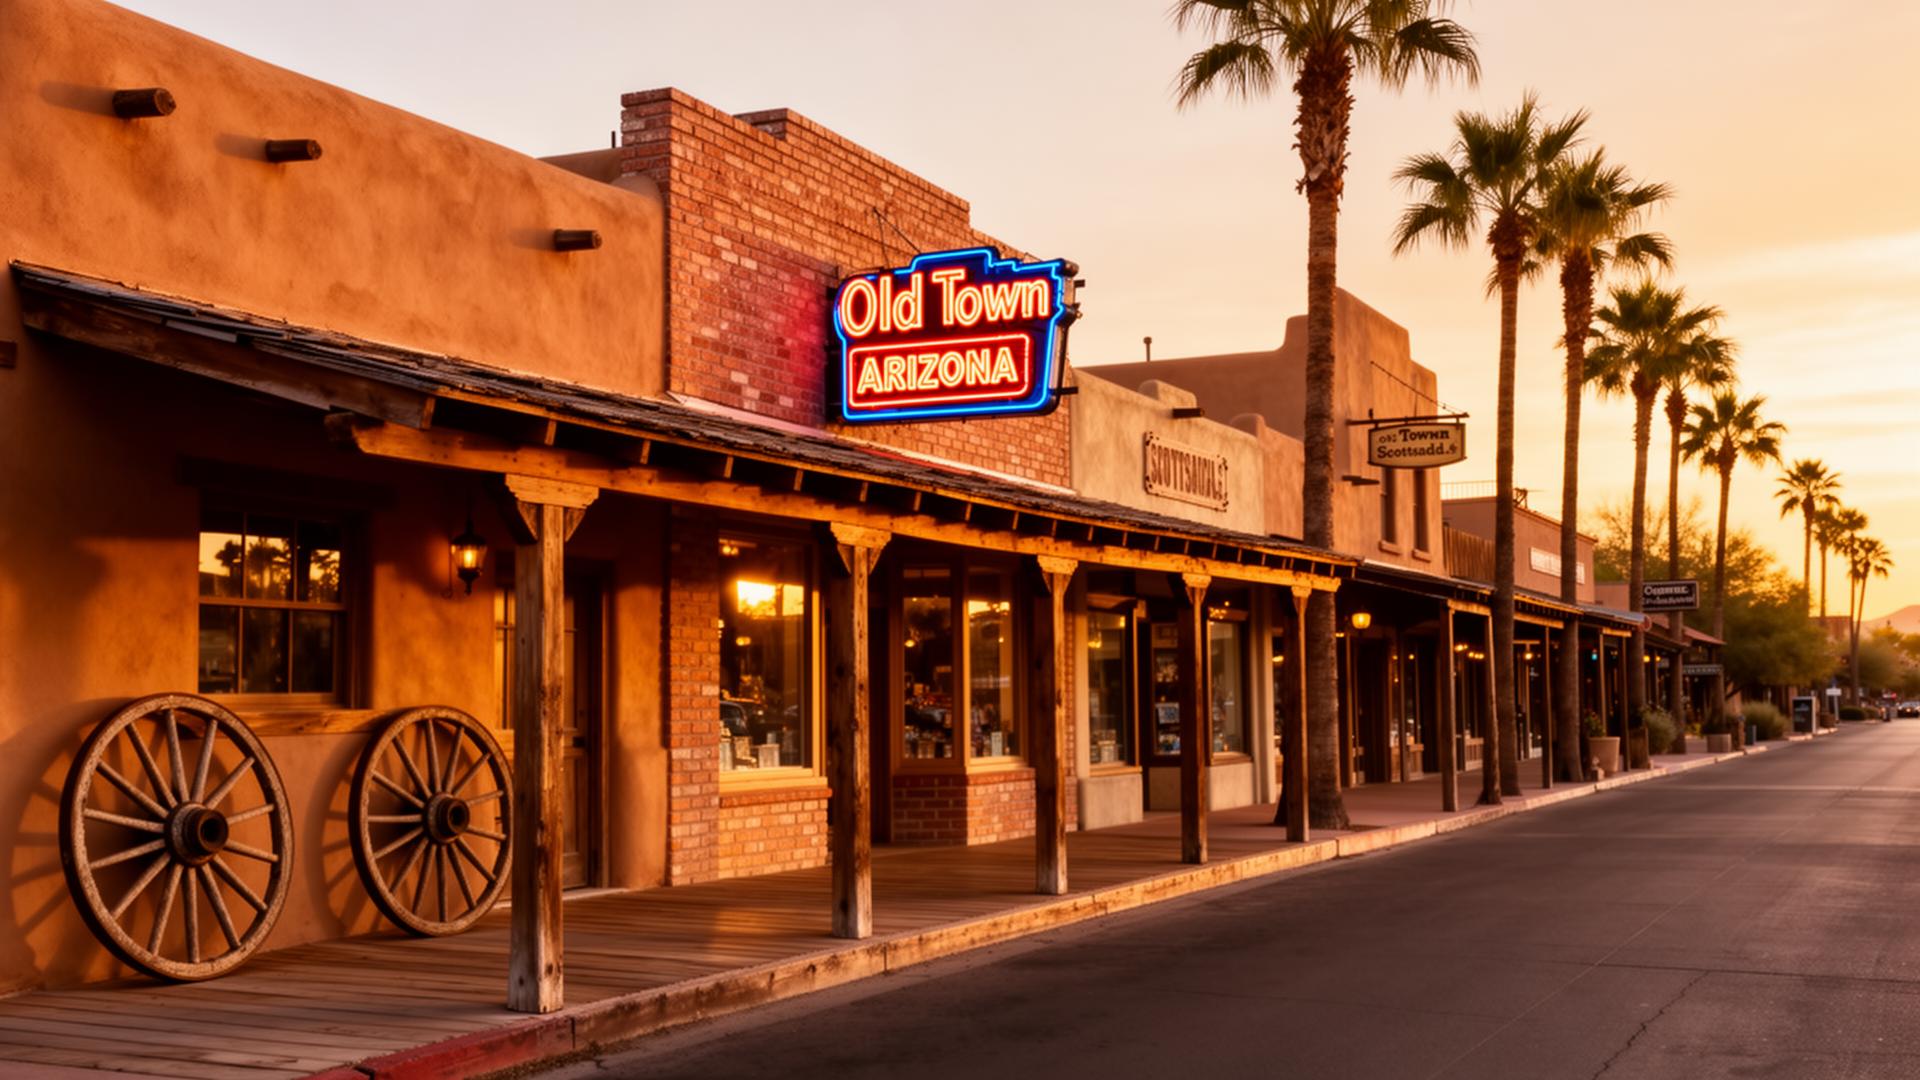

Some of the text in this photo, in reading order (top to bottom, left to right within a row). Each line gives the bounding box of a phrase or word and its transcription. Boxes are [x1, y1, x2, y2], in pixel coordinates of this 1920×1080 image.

[840, 268, 1049, 337] Old Town
[857, 347, 1018, 394] ARIZONA
